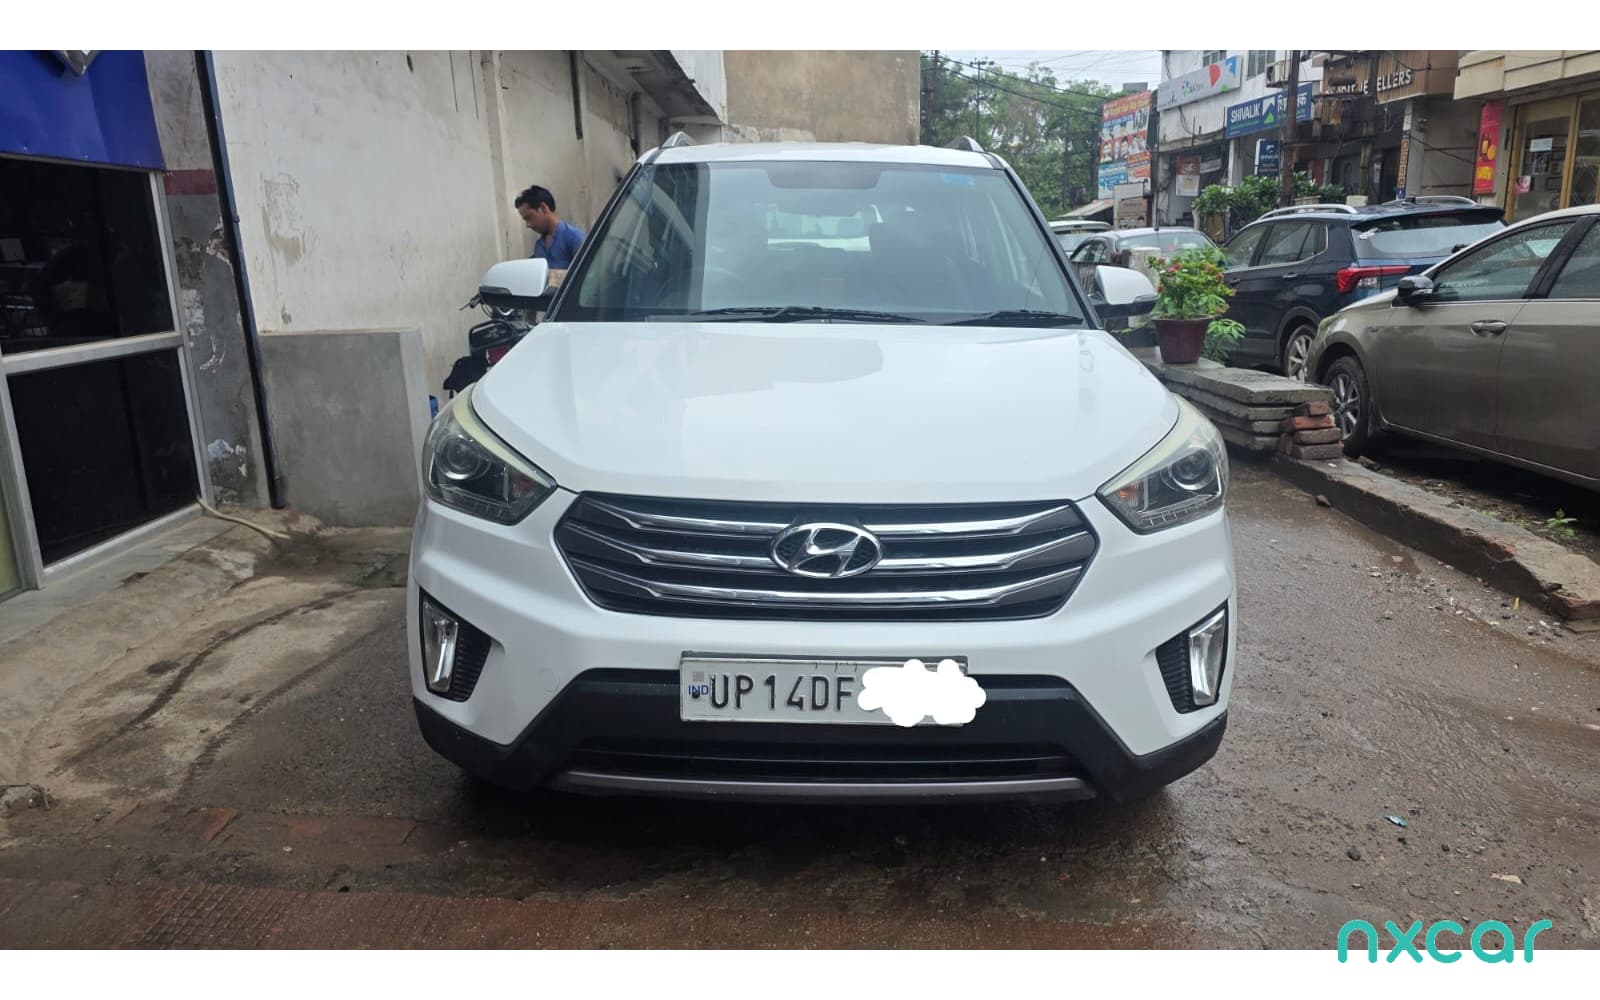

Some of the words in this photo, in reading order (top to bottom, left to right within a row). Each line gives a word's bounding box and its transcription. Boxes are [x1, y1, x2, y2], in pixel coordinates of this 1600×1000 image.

[1360, 69, 1412, 95] JEELLERS
[1230, 103, 1261, 123] SHIVALIK
[688, 684, 709, 698] IND
